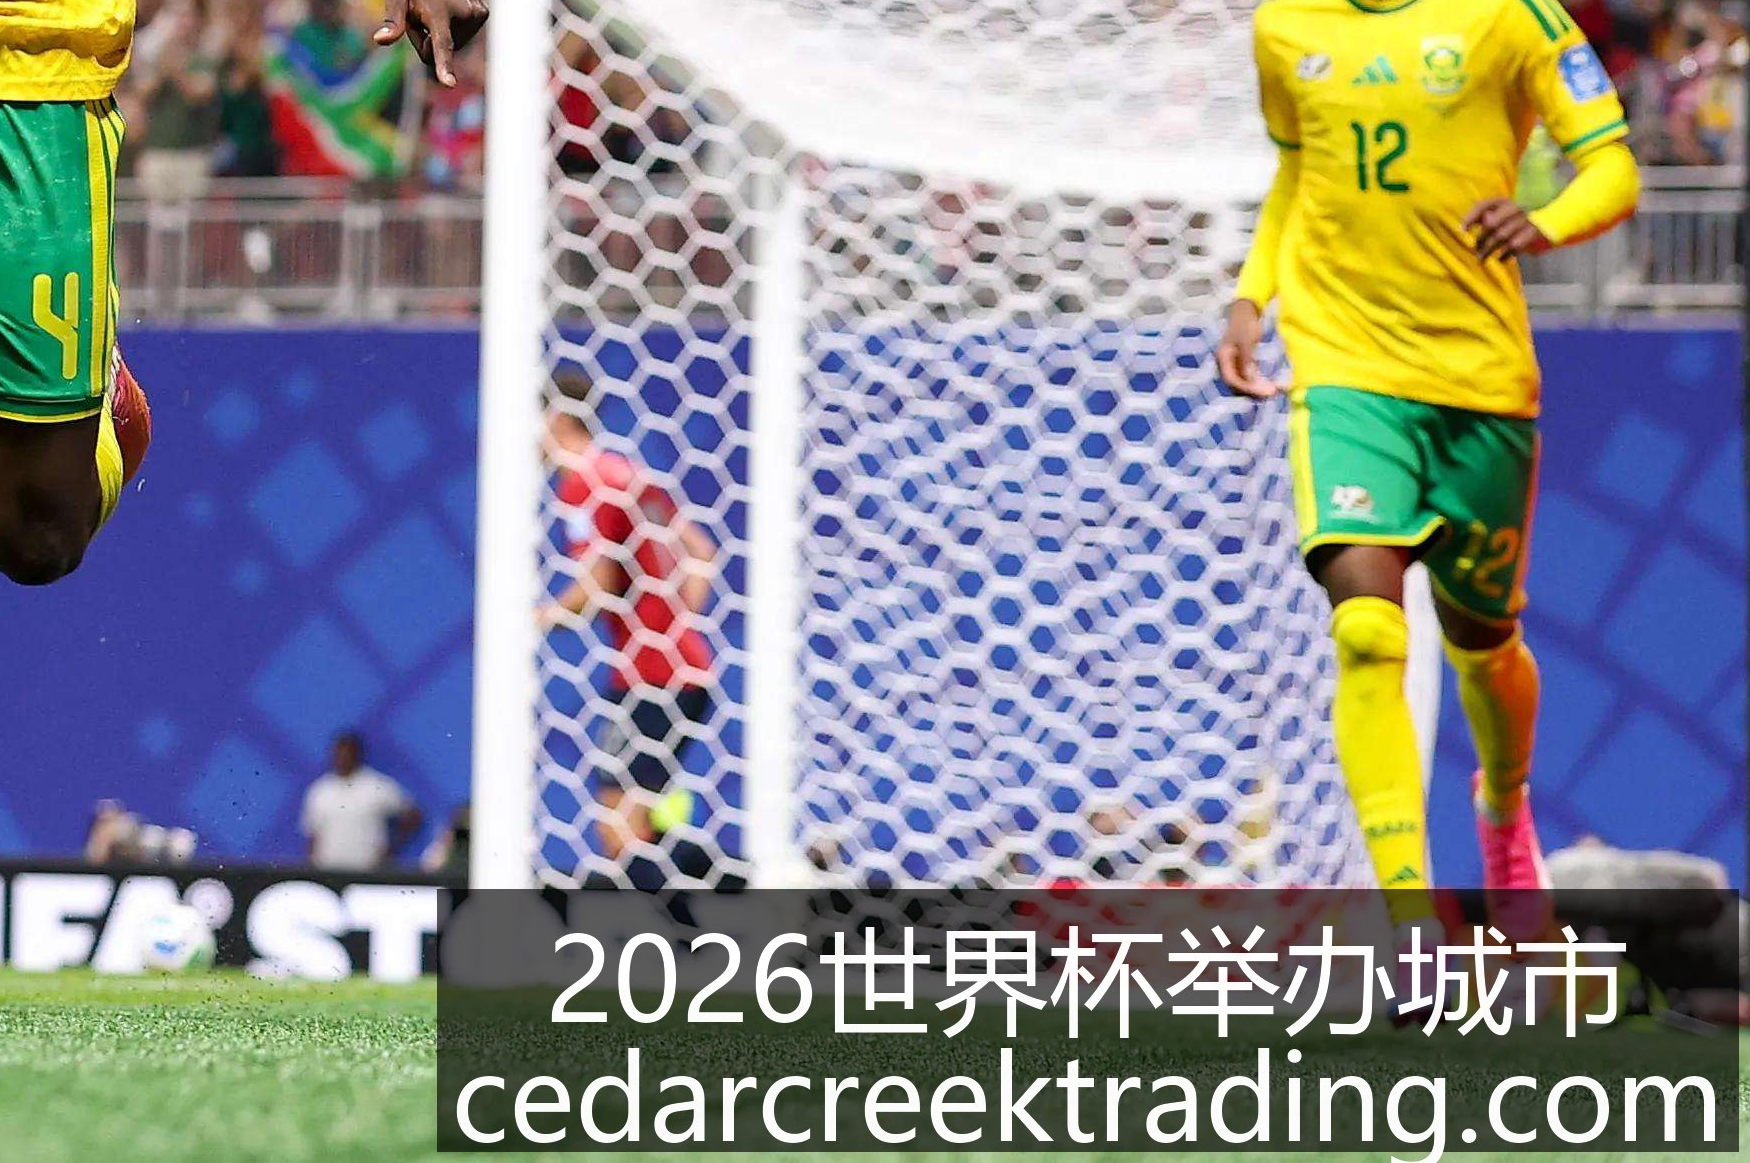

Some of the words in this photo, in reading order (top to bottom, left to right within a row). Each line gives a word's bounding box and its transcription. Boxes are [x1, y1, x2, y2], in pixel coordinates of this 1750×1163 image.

[1351, 120, 1410, 193] 12
[32, 271, 79, 380] 4
[1452, 519, 1520, 599] 12
